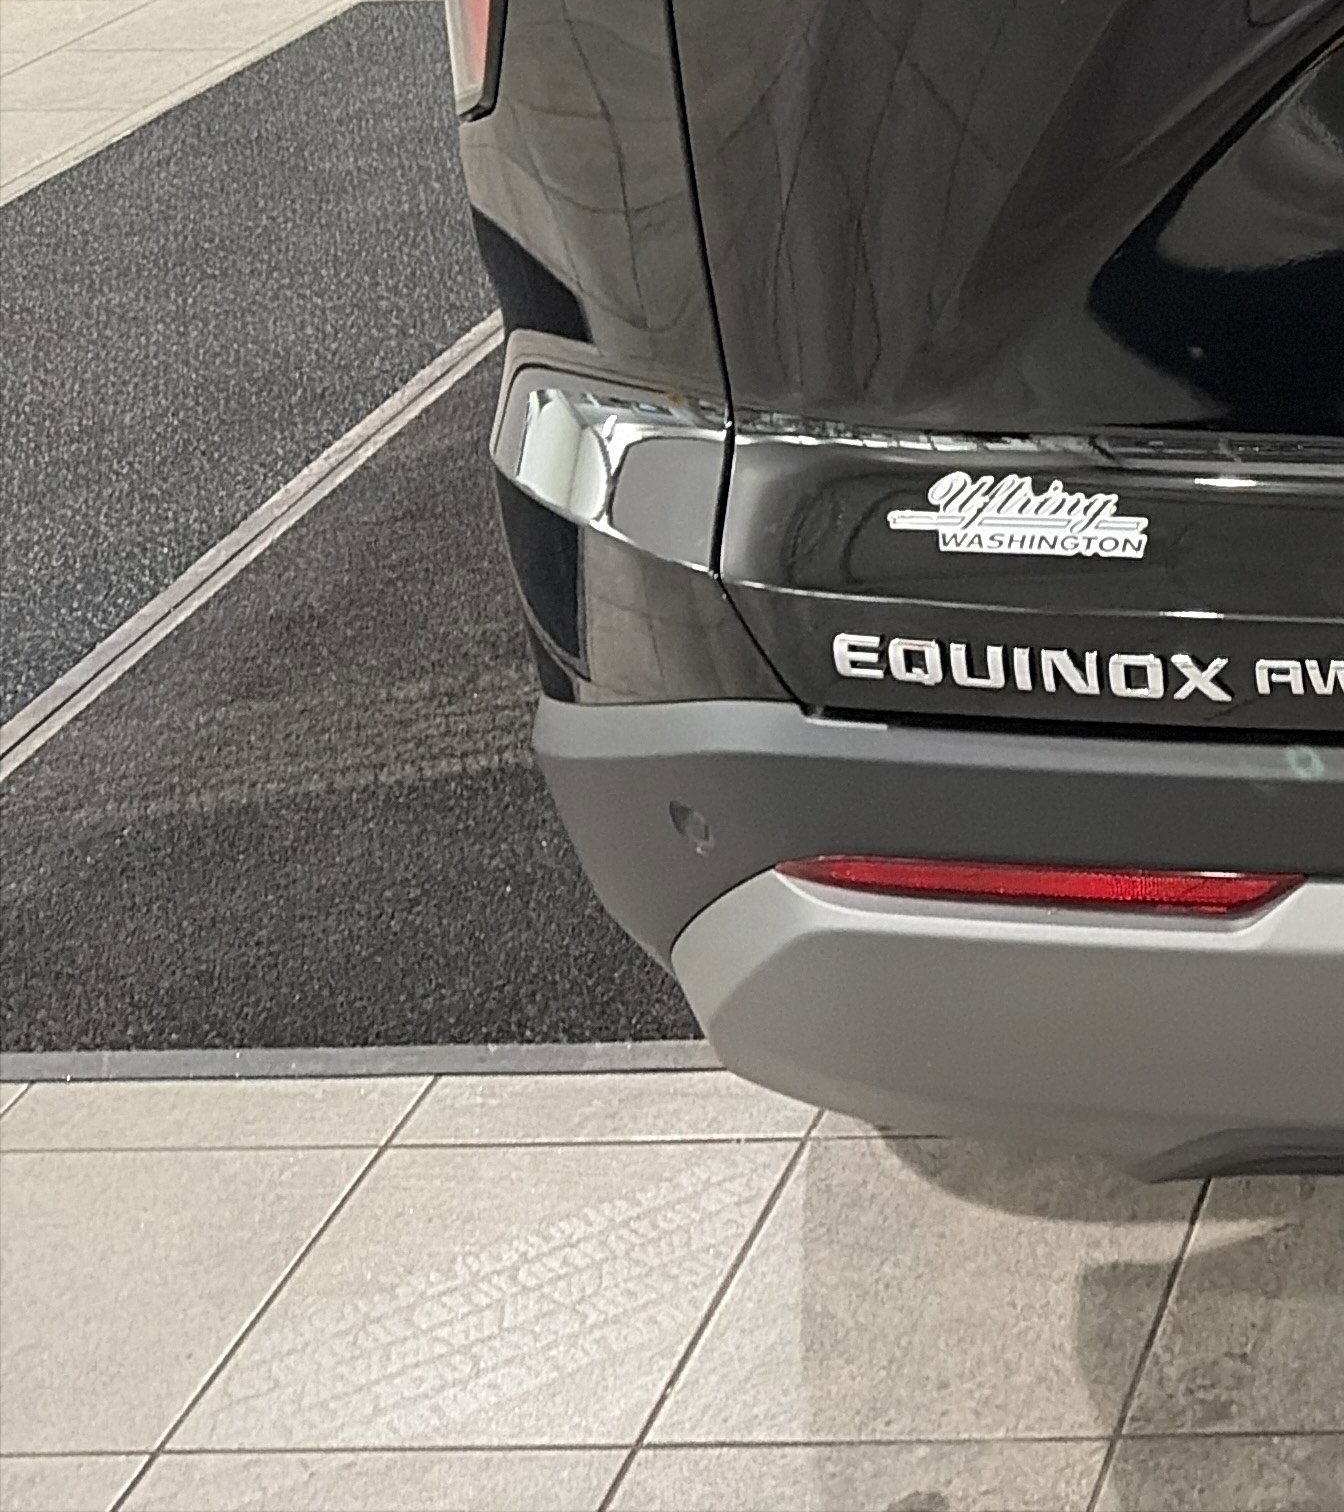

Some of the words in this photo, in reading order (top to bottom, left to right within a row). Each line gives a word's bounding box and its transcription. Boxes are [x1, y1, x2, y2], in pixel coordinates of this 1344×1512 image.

[928, 471, 1119, 534] Uftring
[941, 533, 1144, 553] WASHINGTON
[832, 633, 1233, 702] EQUINOX
